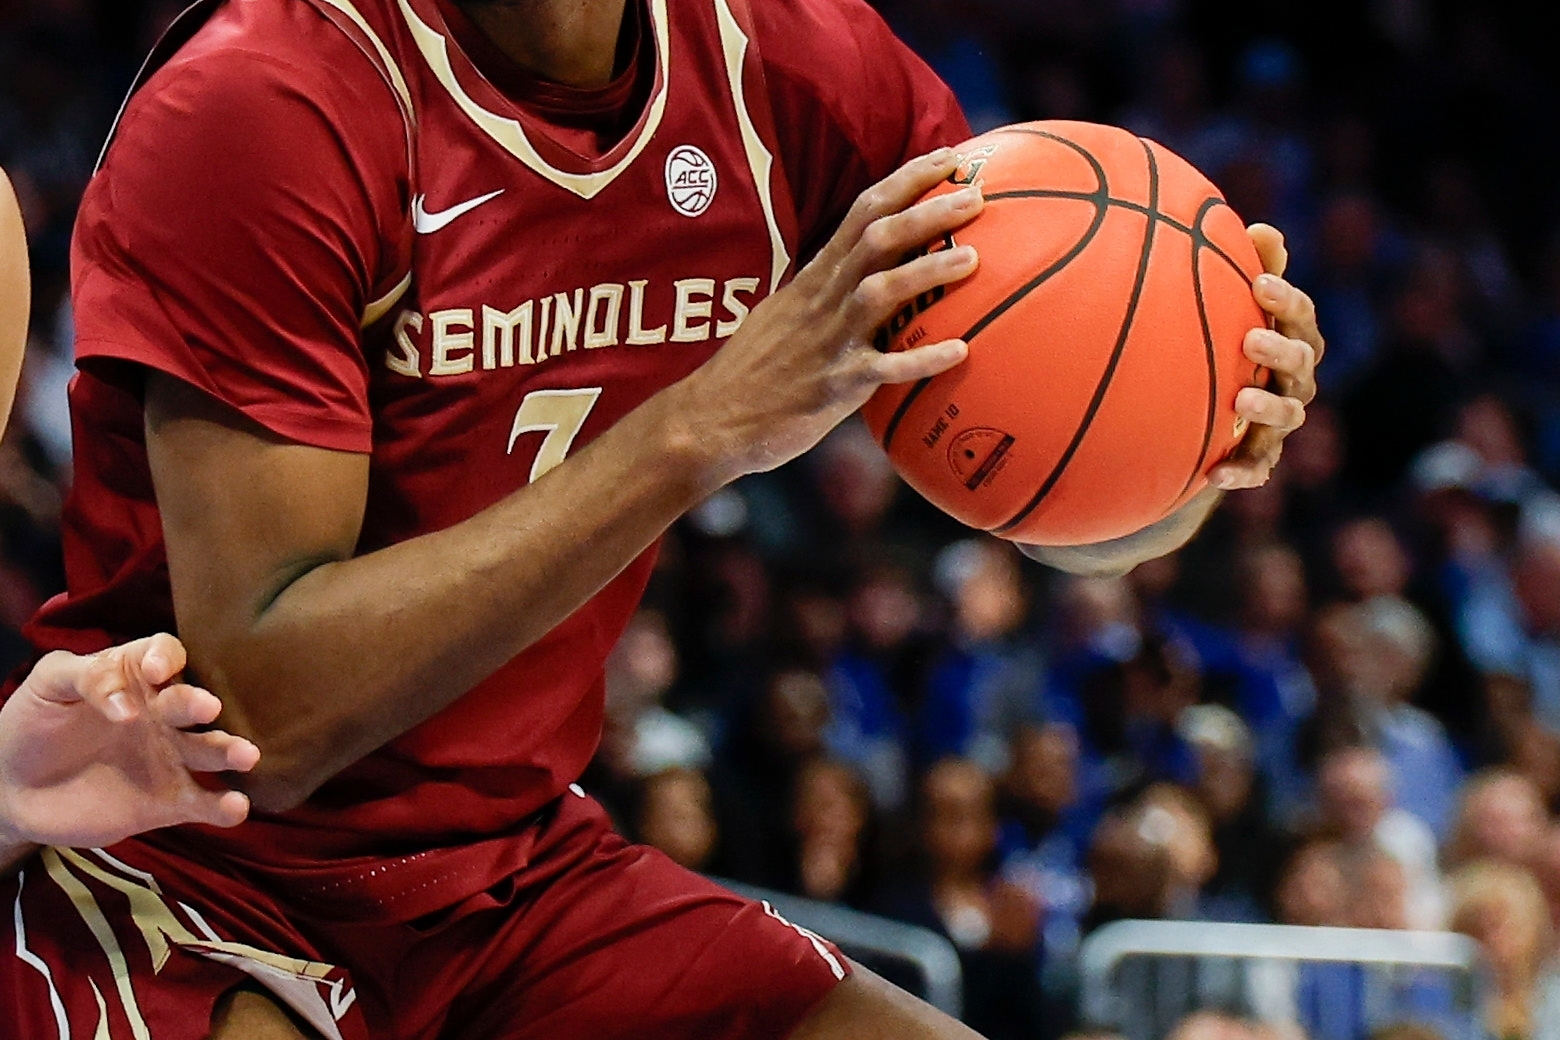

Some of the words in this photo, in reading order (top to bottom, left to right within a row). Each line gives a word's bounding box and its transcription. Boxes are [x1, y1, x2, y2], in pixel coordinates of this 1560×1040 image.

[675, 168, 710, 185] ACC
[386, 277, 760, 379] SEMINOLES
[507, 387, 602, 483] 7
